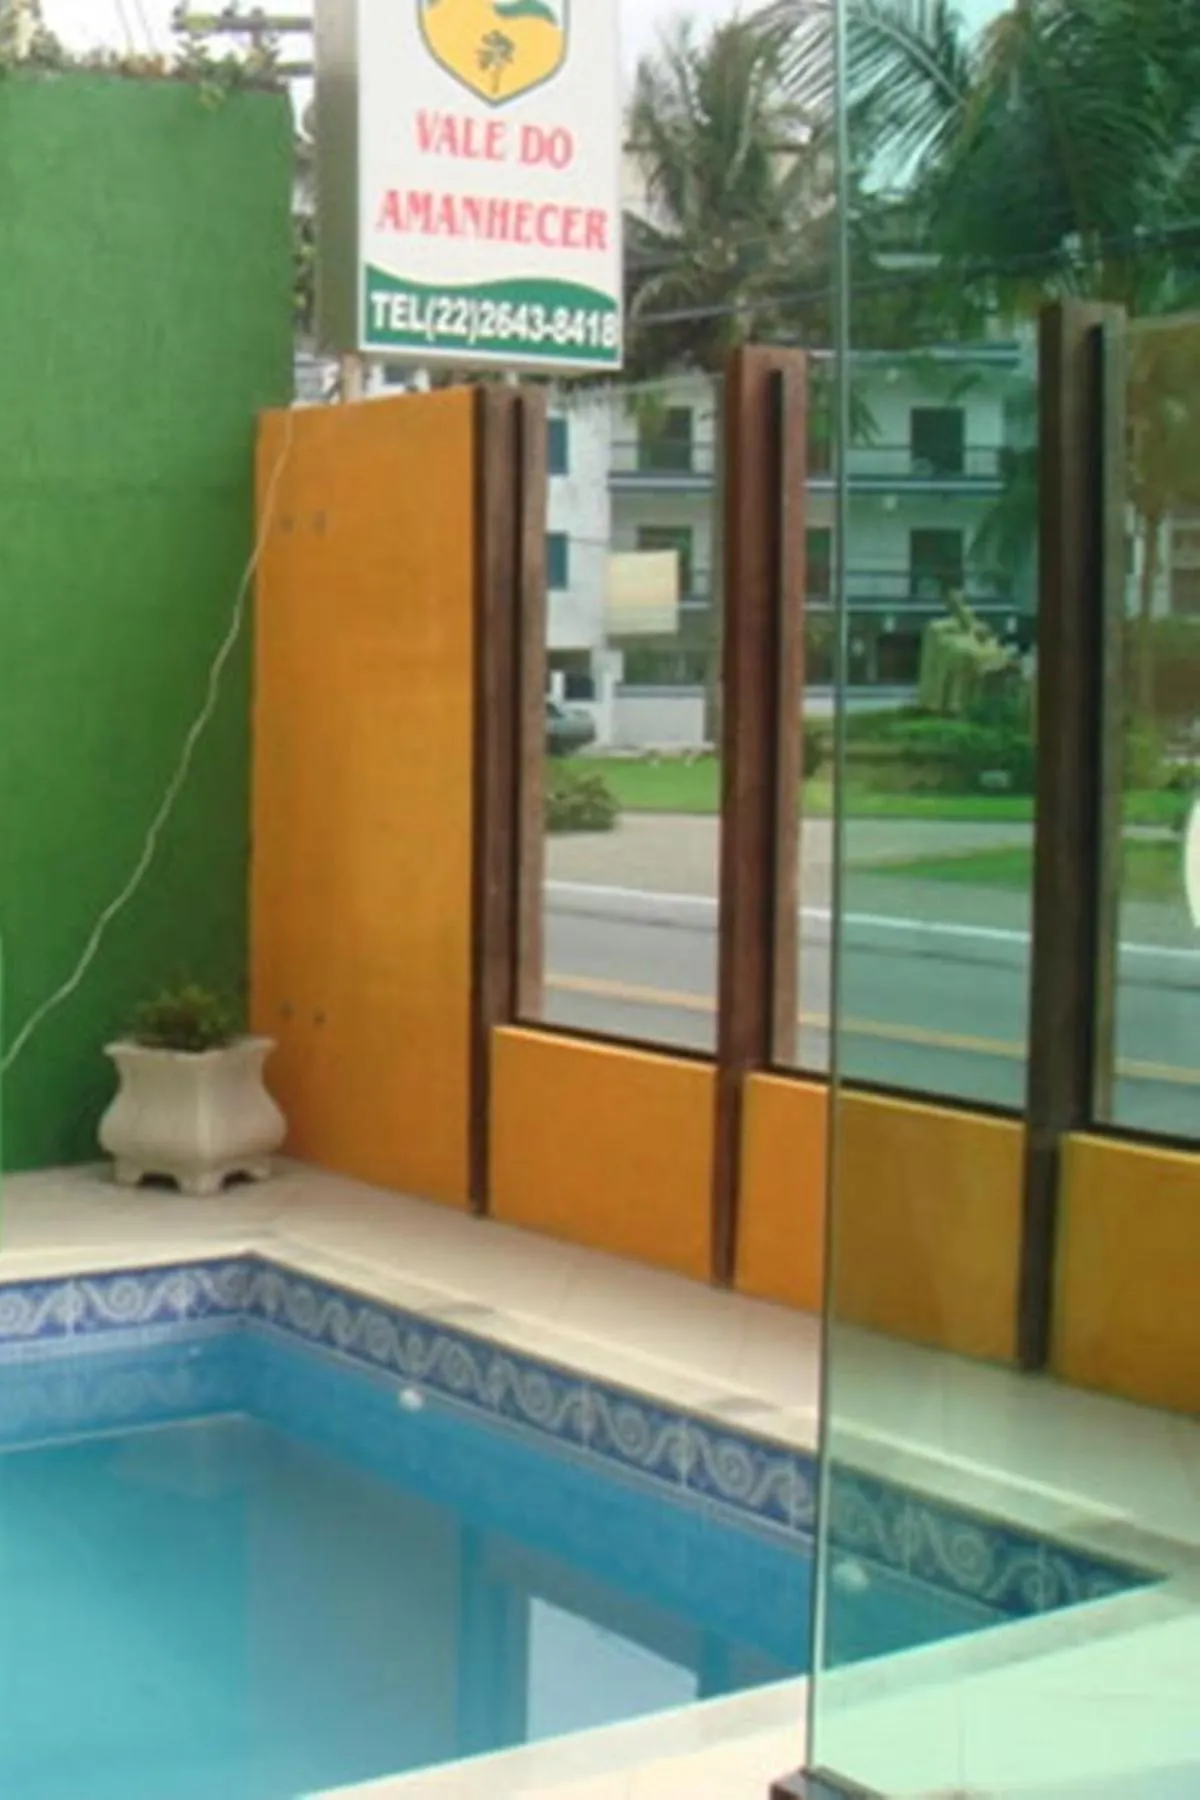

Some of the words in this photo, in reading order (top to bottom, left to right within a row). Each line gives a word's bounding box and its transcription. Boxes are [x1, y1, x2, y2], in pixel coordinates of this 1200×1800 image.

[416, 108, 505, 161] VALE
[519, 123, 574, 169] DO
[375, 189, 608, 251] AMANHECER
